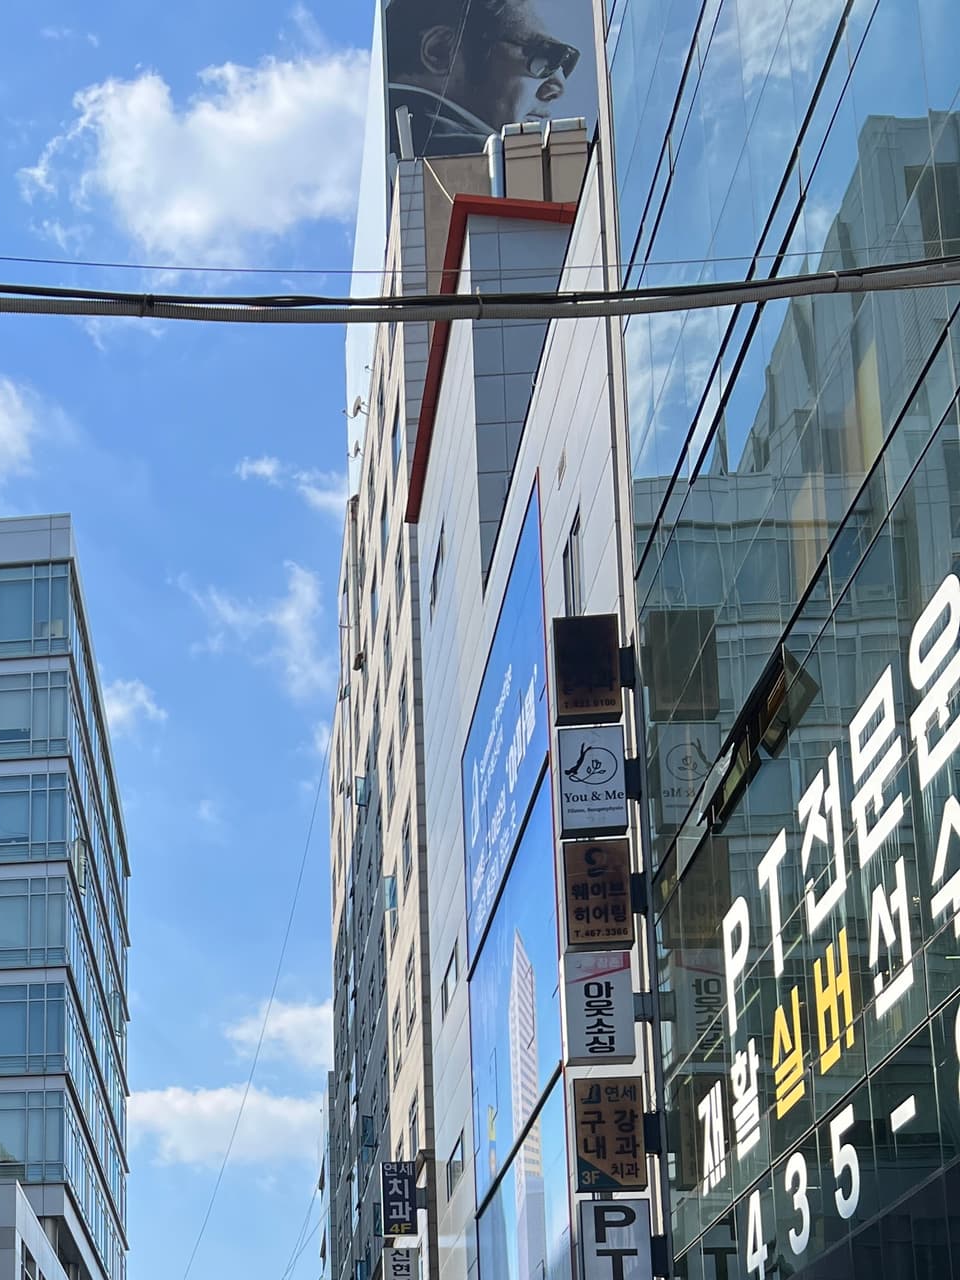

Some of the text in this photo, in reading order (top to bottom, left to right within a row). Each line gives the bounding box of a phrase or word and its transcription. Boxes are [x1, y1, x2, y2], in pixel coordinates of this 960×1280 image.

[564, 789, 624, 803] You & Me
[571, 882, 627, 900] 웨이브
[584, 981, 616, 1053] 아웃소싱
[605, 1084, 637, 1102] 연세
[384, 1163, 413, 1177] 연세
[582, 1171, 600, 1185] 3F
[611, 1162, 640, 1179] 치과
[389, 1178, 413, 1222] 치과
[390, 1223, 413, 1234] 4F
